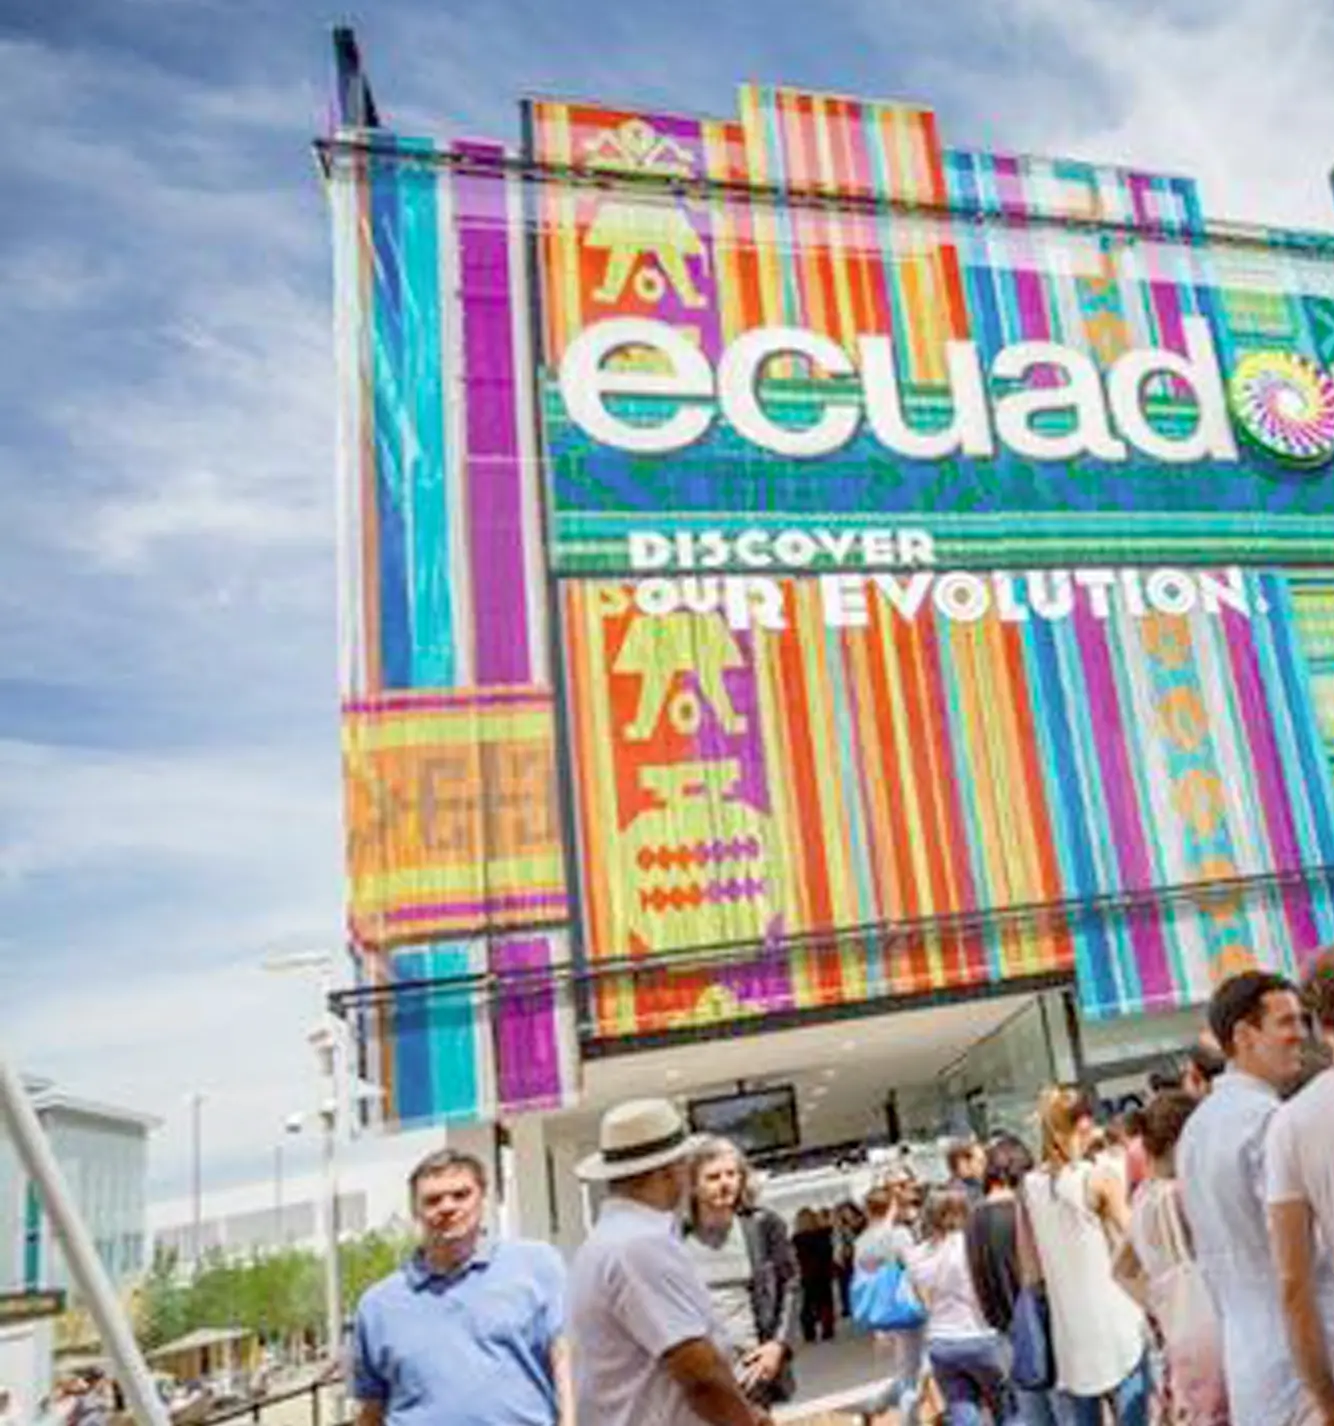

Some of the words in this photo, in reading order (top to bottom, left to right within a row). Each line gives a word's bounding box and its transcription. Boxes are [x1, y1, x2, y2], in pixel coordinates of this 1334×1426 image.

[628, 528, 936, 568] DISCOVER
[633, 572, 787, 630] OUR
[820, 565, 1270, 627] EVOLUTION.
